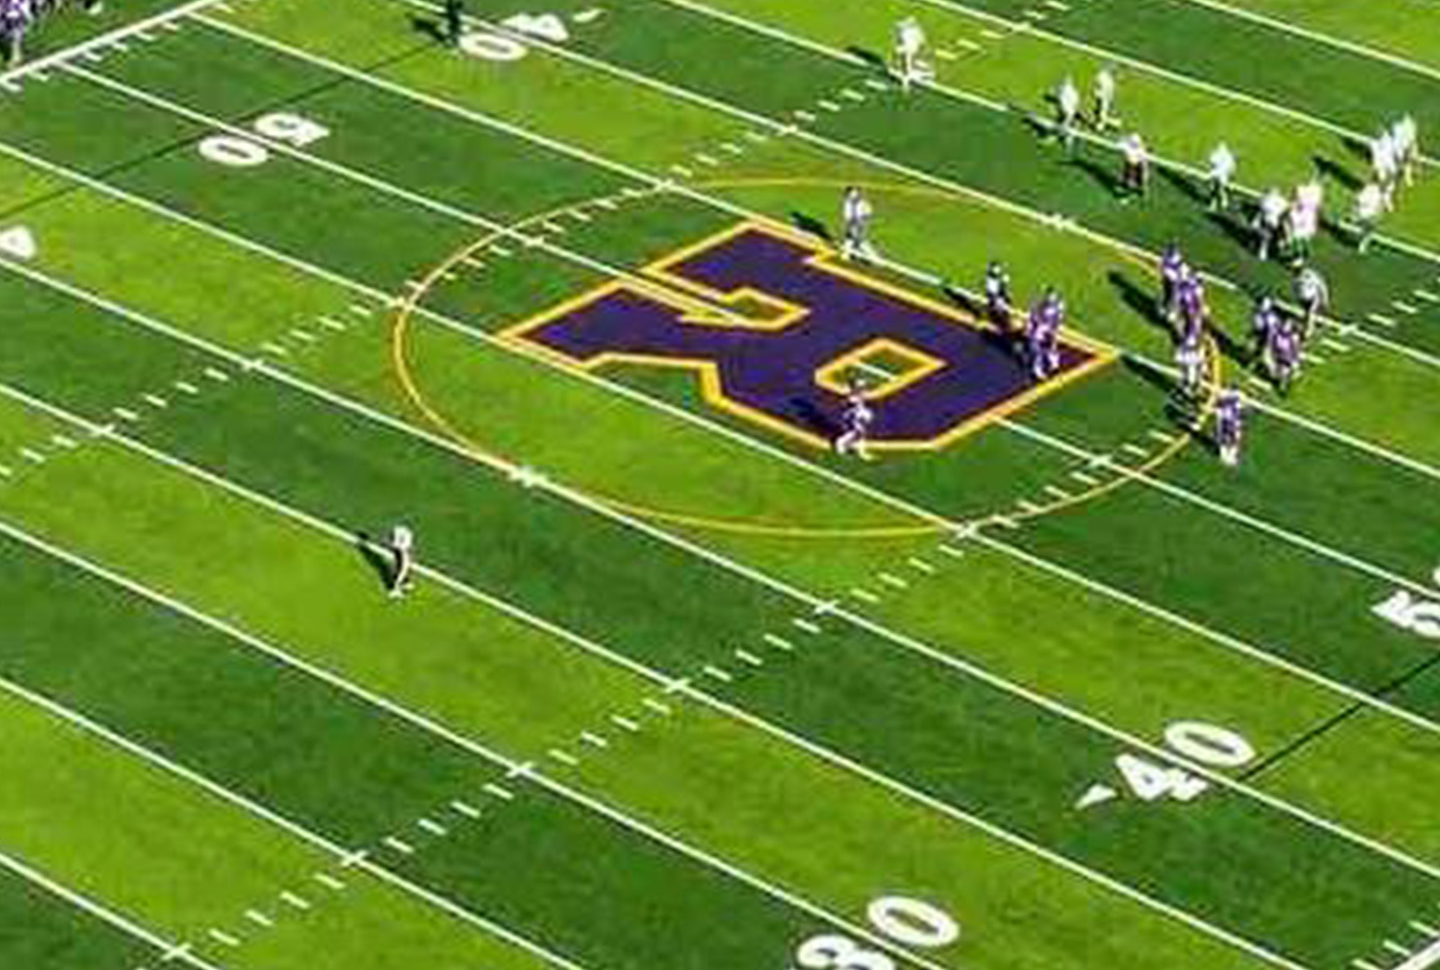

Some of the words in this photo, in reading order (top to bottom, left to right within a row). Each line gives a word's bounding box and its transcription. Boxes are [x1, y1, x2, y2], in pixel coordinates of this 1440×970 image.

[199, 112, 331, 167] 50
[498, 220, 1120, 450] R
[1115, 721, 1257, 801] 40
[797, 896, 961, 970] 30
